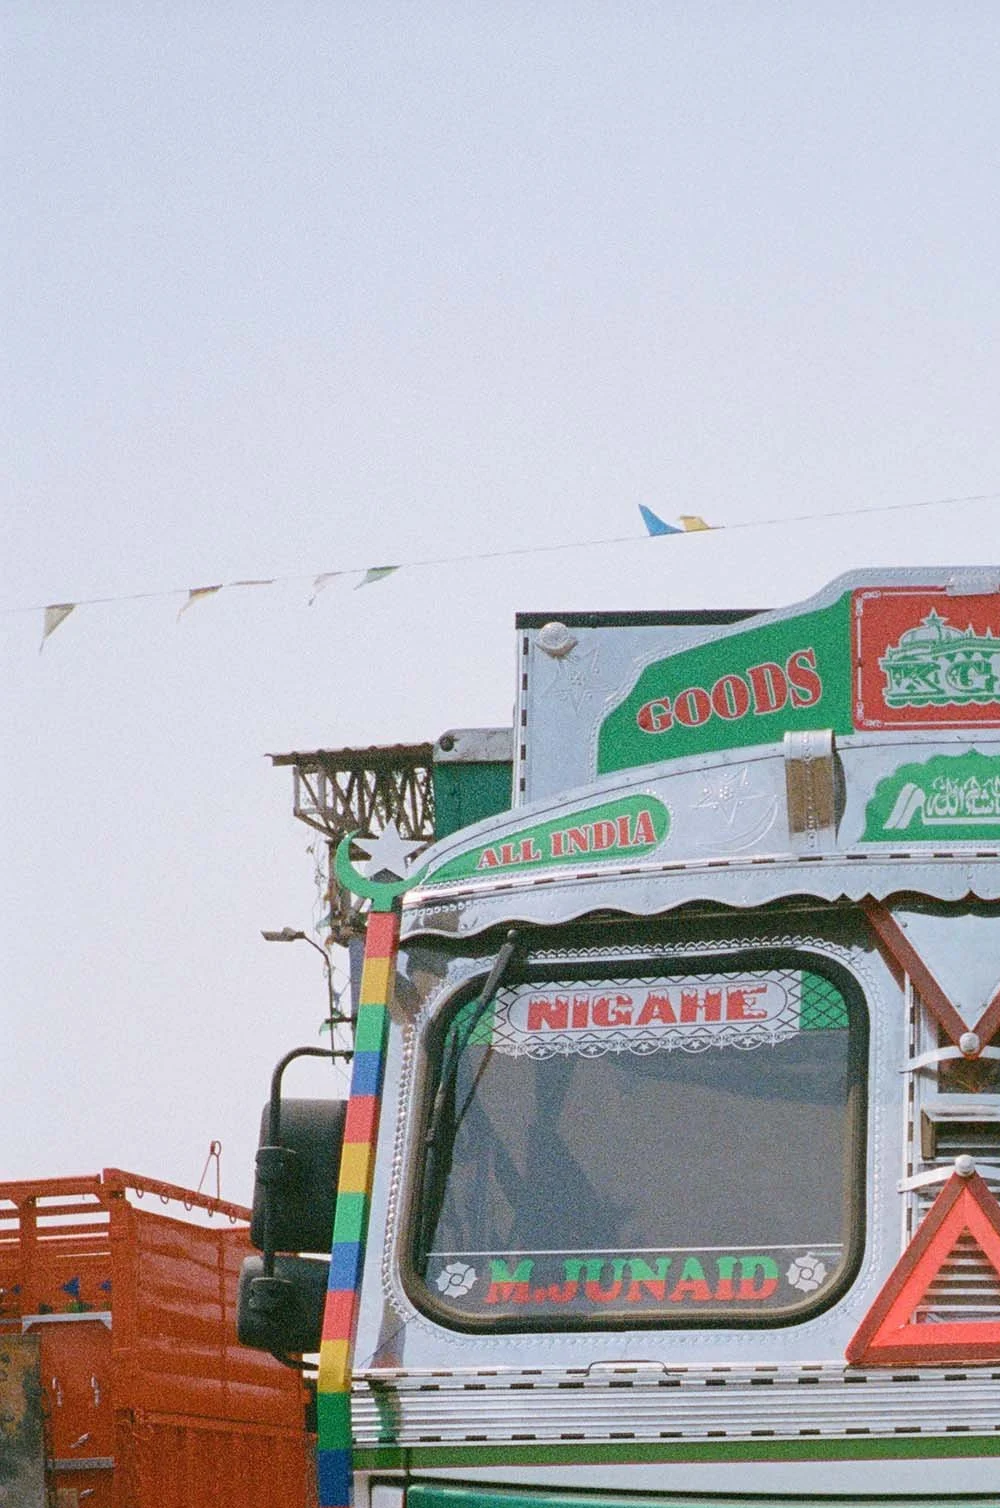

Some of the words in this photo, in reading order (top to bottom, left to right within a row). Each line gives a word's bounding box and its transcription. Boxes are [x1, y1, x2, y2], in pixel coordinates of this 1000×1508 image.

[636, 648, 823, 733] GOODS
[477, 840, 540, 869] ALL
[551, 809, 658, 857] INDIA
[526, 984, 768, 1031] NIGAHE
